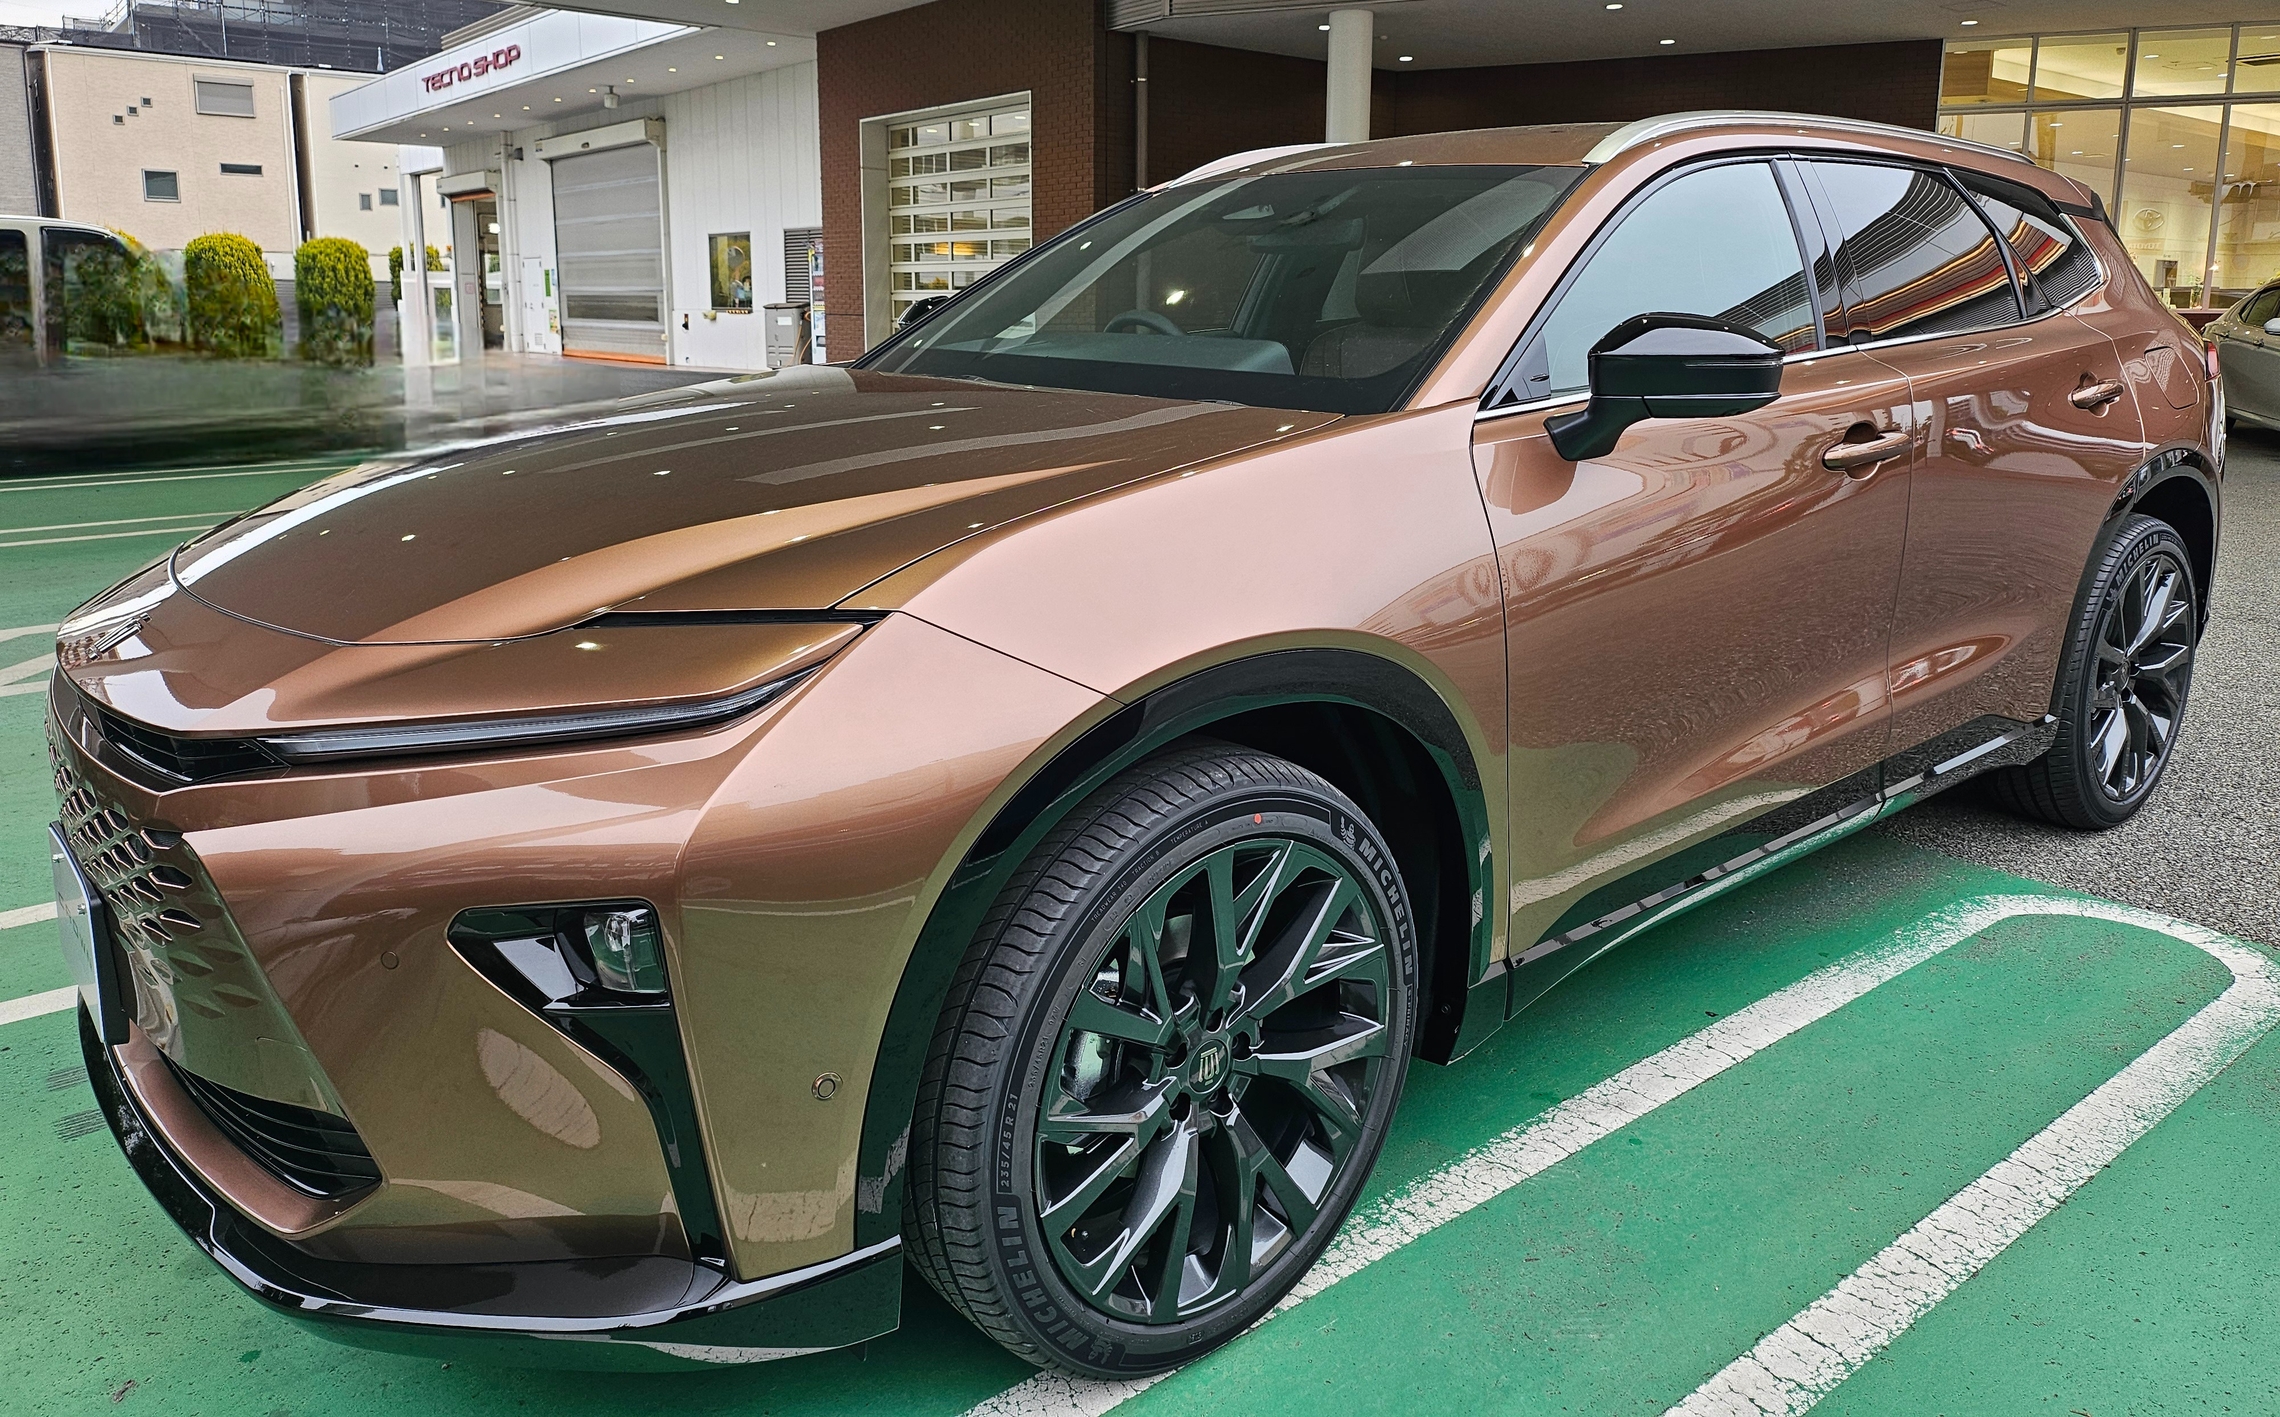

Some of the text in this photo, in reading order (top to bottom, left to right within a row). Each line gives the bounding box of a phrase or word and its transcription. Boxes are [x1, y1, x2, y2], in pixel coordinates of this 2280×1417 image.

[421, 44, 521, 93] TECNO SHOP
[2115, 533, 2160, 587] MICHELIN
[1358, 837, 1414, 975] MICHELIN
[1000, 1092, 1018, 1188] 235/45 R 21
[997, 1205, 1090, 1352] MICHELIN
